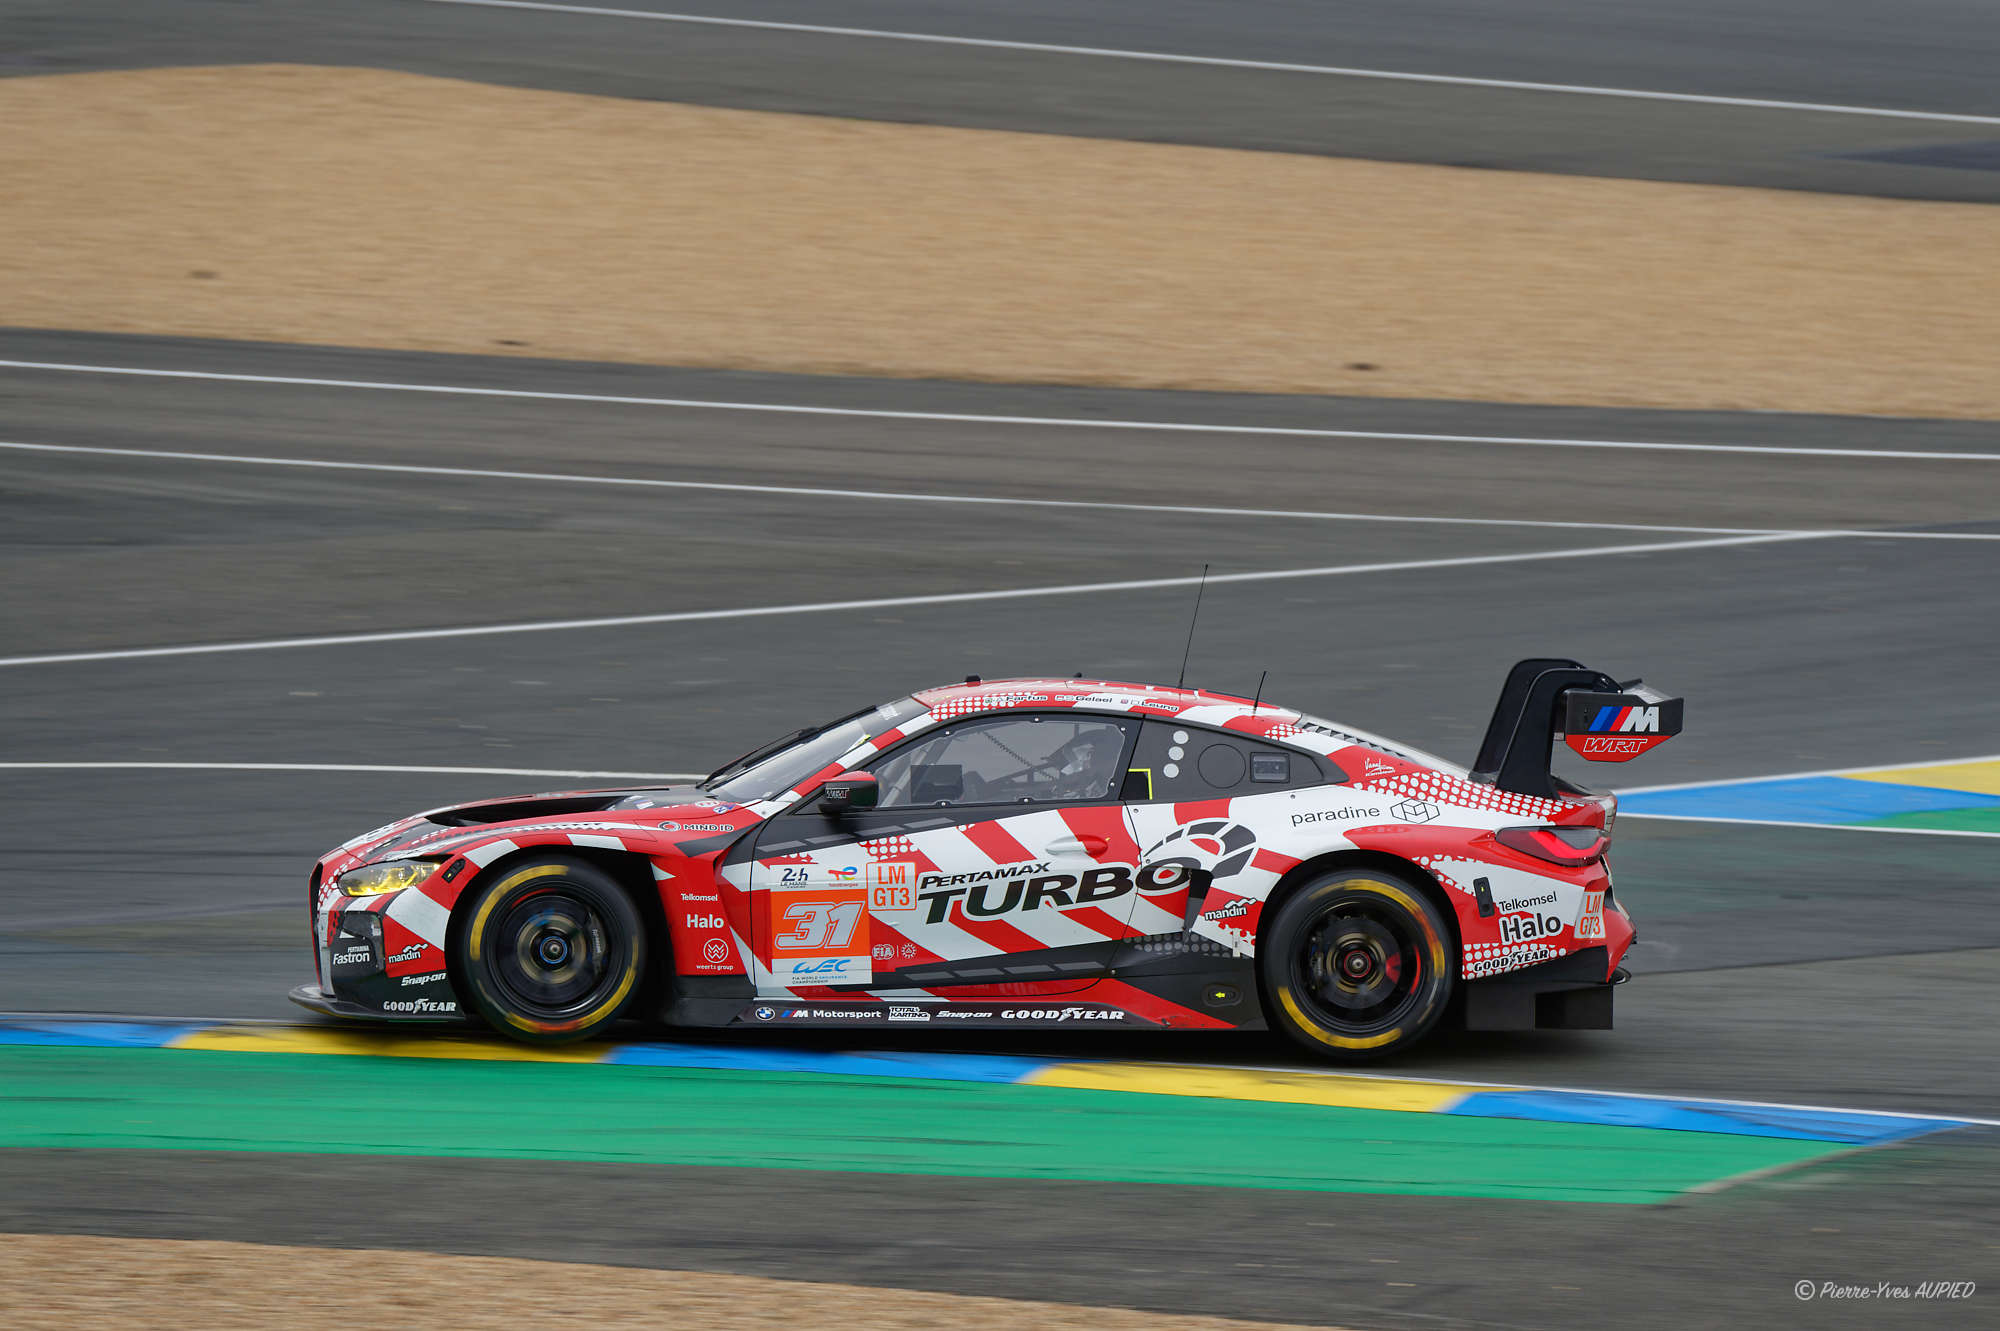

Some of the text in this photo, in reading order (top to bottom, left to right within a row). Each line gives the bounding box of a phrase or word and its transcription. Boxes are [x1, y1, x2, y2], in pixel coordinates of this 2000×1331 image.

[1583, 737, 1648, 752] WRT
[1291, 806, 1380, 827] paradine
[683, 823, 734, 832] MIND ID
[877, 865, 905, 884] LM
[919, 862, 1051, 890] PERTAMAX
[680, 893, 718, 902] Telkomsel
[873, 887, 910, 907] GT3
[918, 856, 1201, 924] TURBO
[1499, 891, 1557, 912] Telkomsel
[1585, 895, 1602, 914] LM
[686, 914, 725, 928] Halo
[774, 900, 866, 950] 31
[1501, 913, 1562, 942] Halo
[1579, 915, 1601, 935] GT3
[333, 951, 370, 965] Fastron
[792, 959, 851, 974] WEC
[401, 972, 447, 986] Snap-on
[813, 1010, 882, 1019] Motorsport
[936, 1010, 992, 1019] Snap-on
